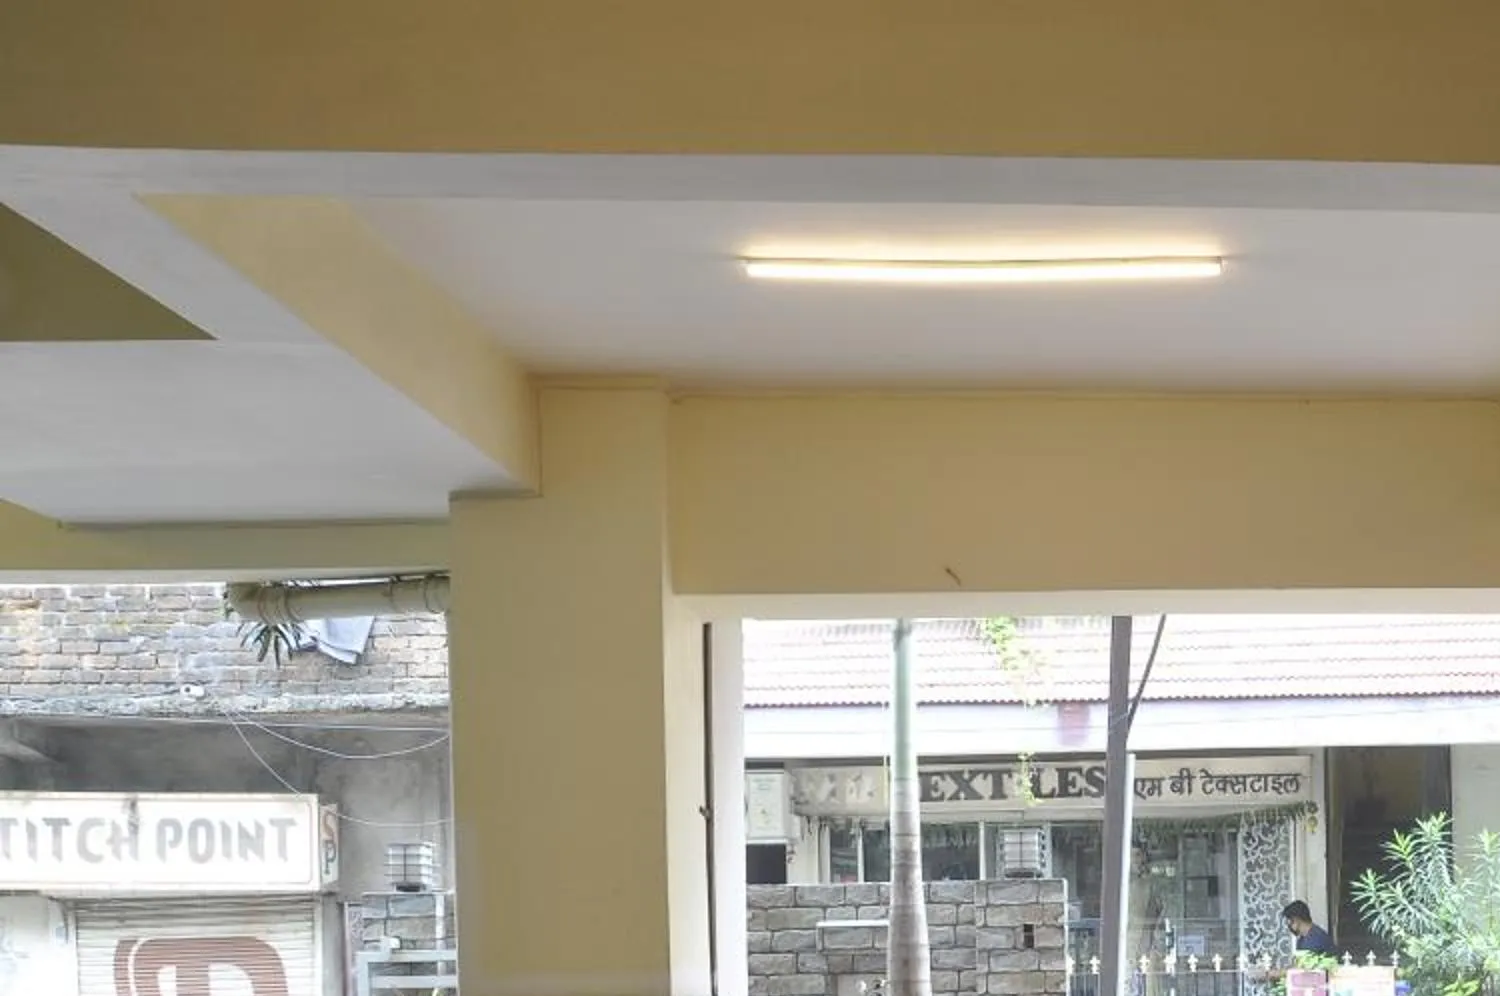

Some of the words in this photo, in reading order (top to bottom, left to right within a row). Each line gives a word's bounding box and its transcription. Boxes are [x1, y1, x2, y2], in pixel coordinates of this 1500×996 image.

[919, 766, 1105, 801] EXTLES
[1169, 768, 1197, 796] बी
[1199, 769, 1301, 796] टेक्सटाइल
[156, 817, 297, 864] POINT
